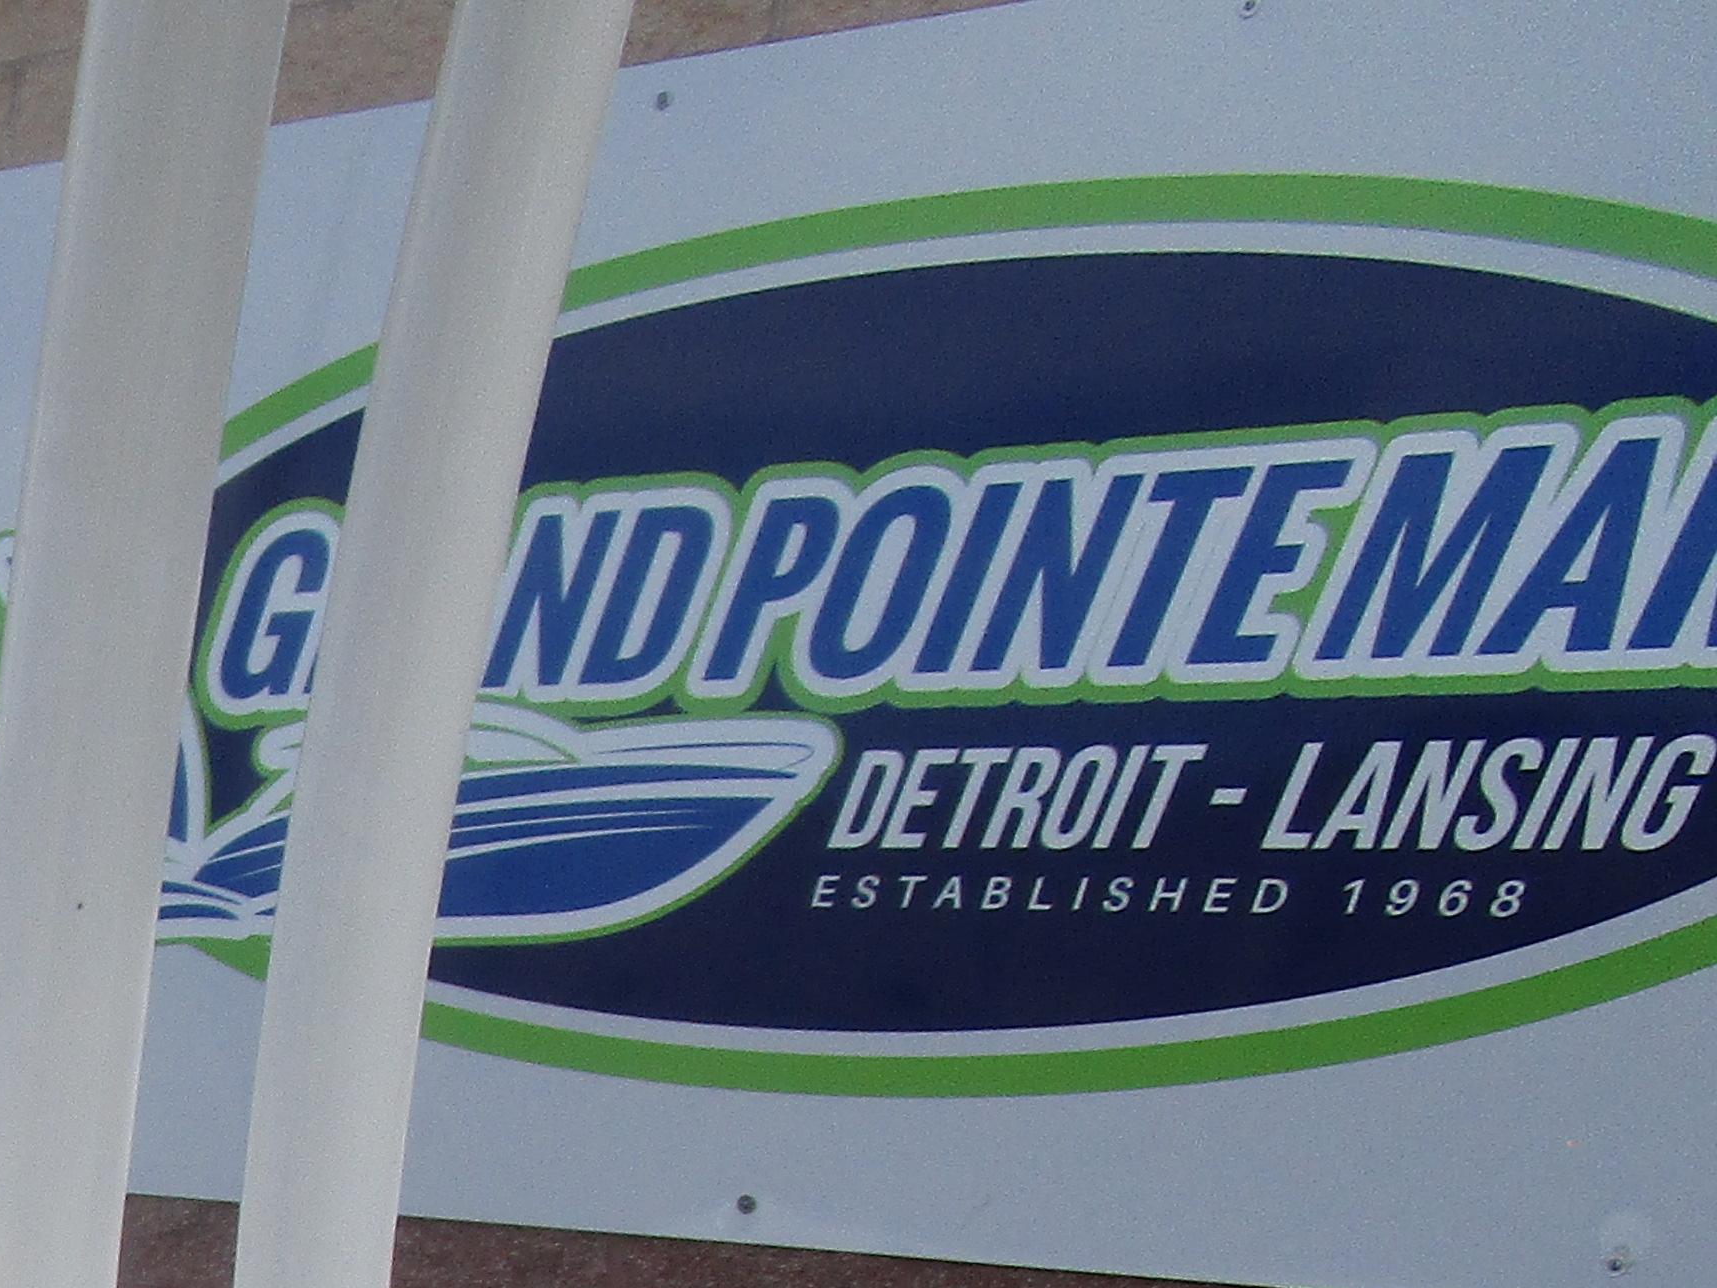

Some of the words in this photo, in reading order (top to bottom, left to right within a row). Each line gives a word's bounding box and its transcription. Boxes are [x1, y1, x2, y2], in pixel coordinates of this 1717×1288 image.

[215, 500, 715, 702] GND
[723, 454, 1359, 696] POINTE
[827, 743, 1208, 851] DETROIT
[1260, 734, 1717, 851] LANSING
[810, 873, 1292, 915] ESTABLISHED
[1339, 876, 1530, 920] 1968
